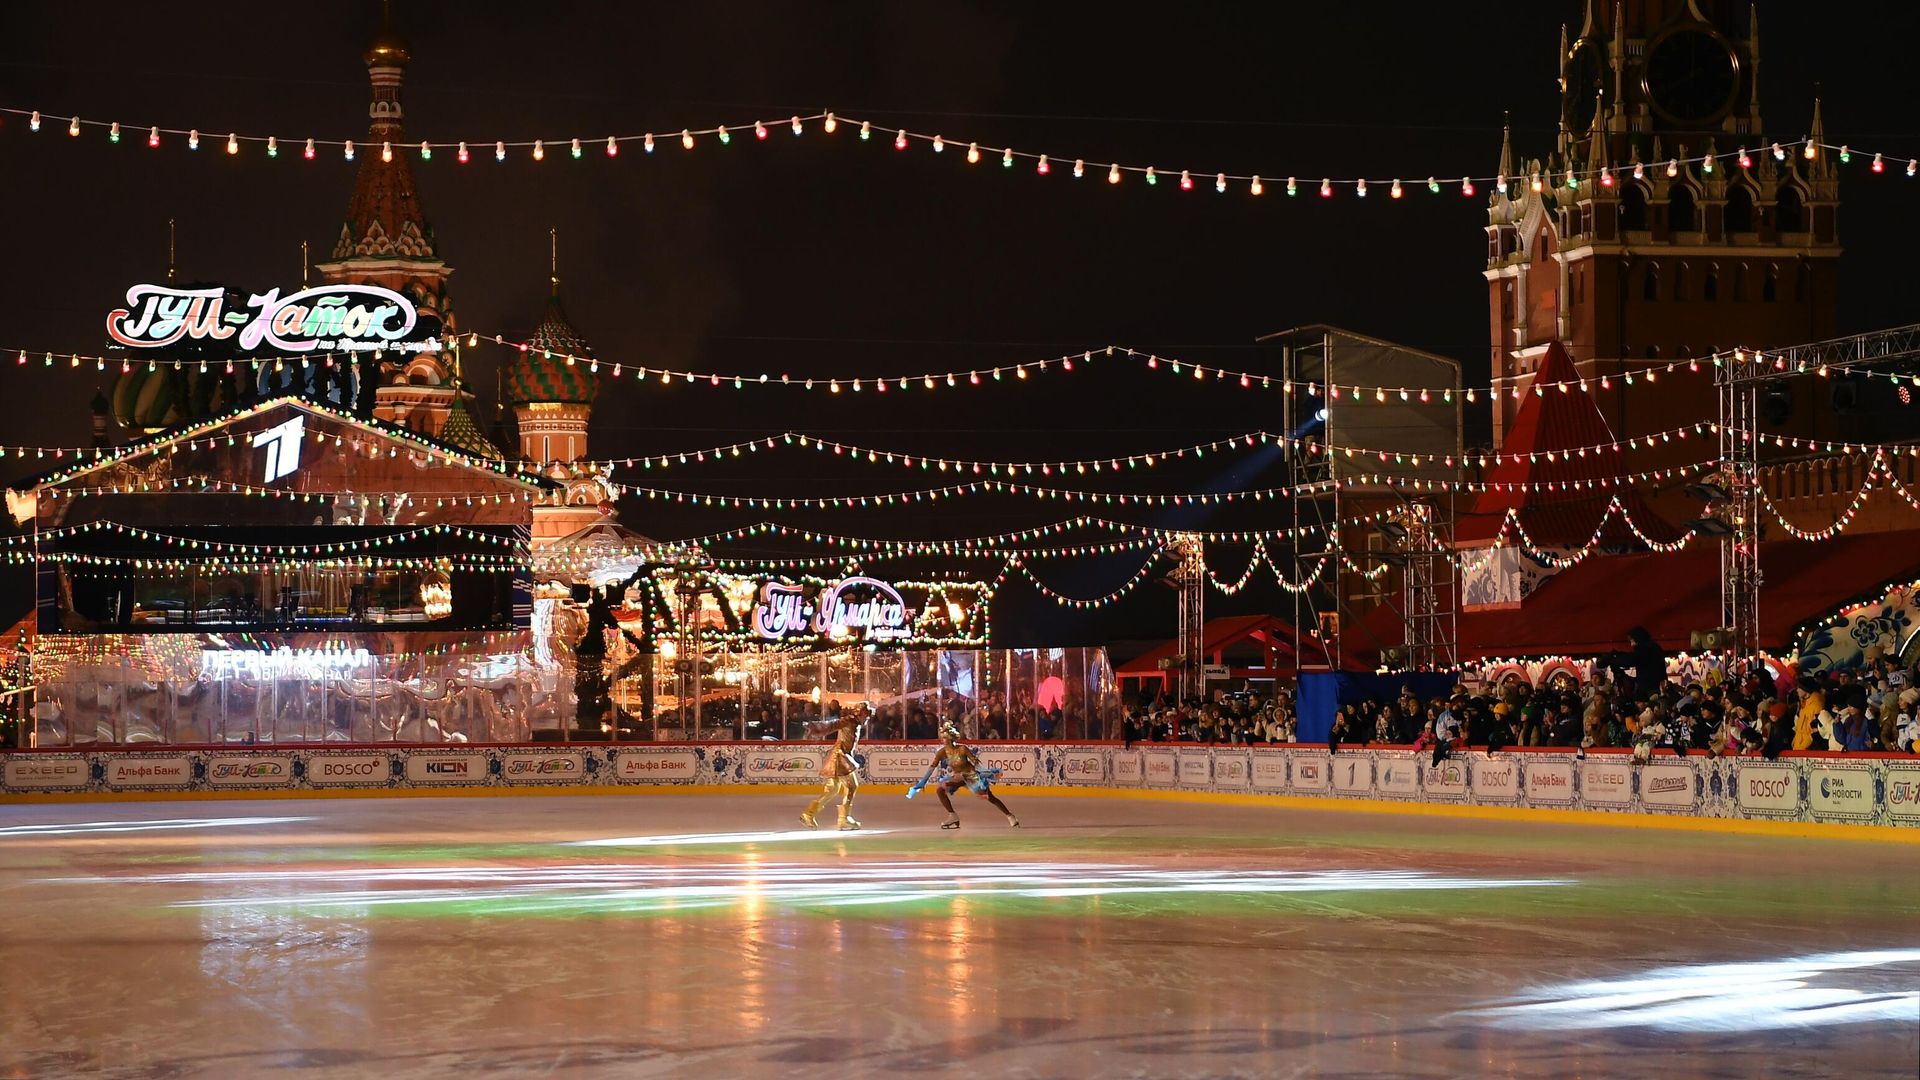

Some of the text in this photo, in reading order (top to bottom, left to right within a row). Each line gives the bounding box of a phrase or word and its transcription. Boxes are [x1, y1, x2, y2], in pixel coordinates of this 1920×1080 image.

[202, 646, 370, 667] ПЕРВЫЙ КАНАЛ
[426, 762, 468, 773] KION
[626, 760, 687, 772] Альфа Банк
[878, 758, 930, 766] EXEED
[987, 759, 1023, 771] BOSCO
[15, 766, 78, 774] EXEED
[117, 766, 181, 778] Альфа Банк
[324, 763, 373, 775] BOSCO
[1256, 764, 1281, 774] EXEED
[1301, 765, 1319, 779] KION
[1482, 771, 1508, 787] BOSCO
[1531, 773, 1567, 788] Альфа Банк
[1588, 773, 1625, 785] EXEED
[1831, 778, 1845, 788] РИА
[1750, 779, 1785, 798] BOSCO
[1832, 789, 1862, 799] НОВОСТИ
